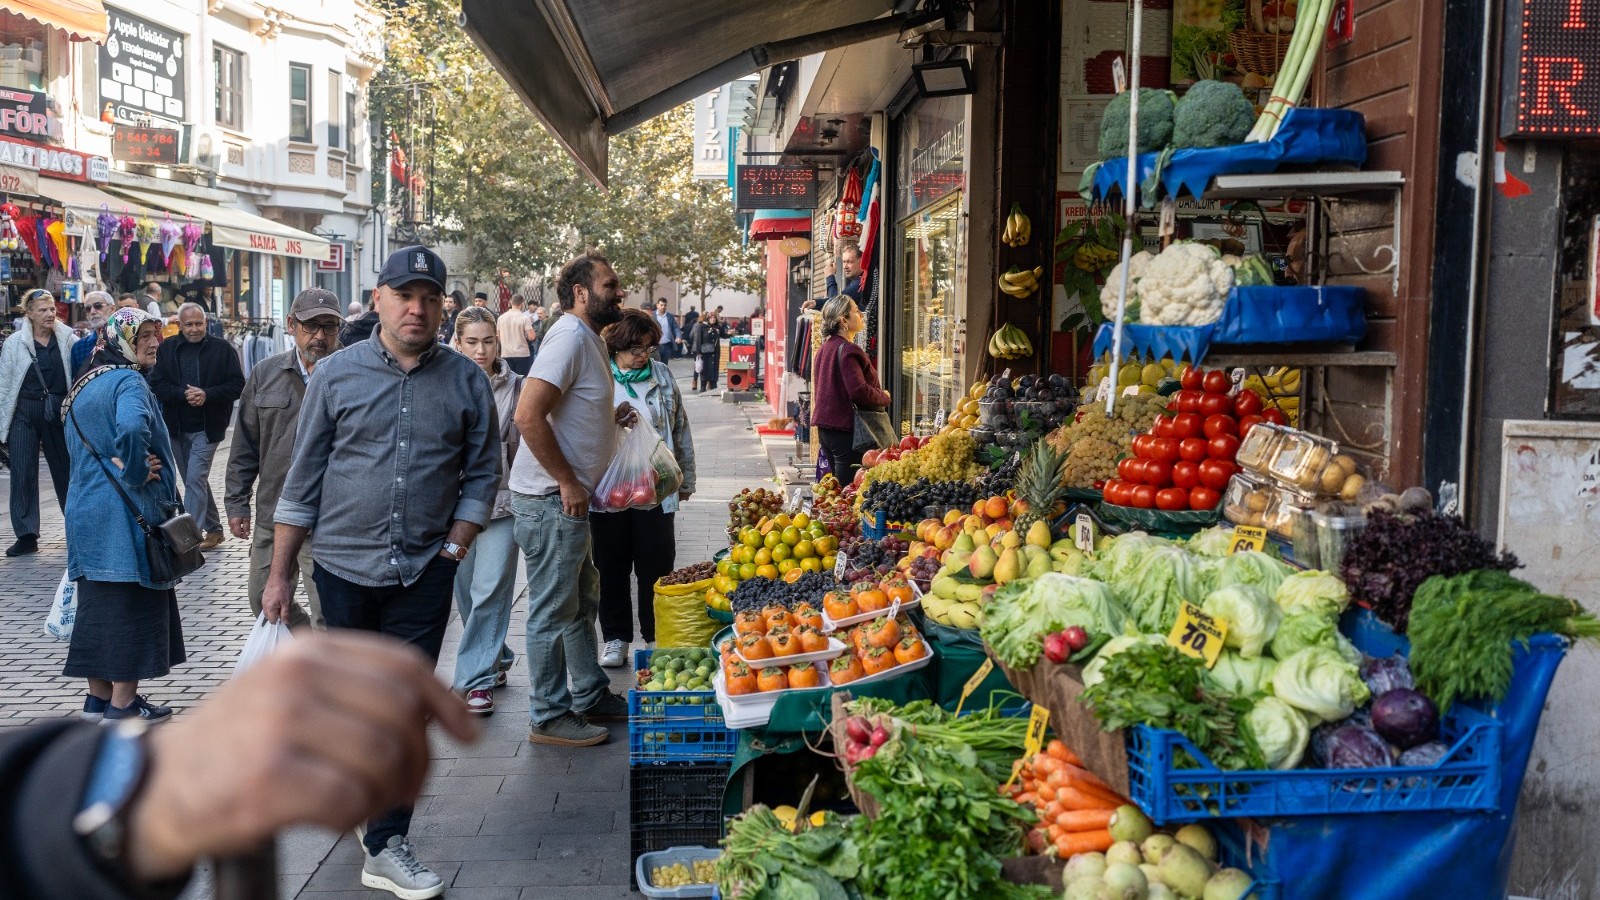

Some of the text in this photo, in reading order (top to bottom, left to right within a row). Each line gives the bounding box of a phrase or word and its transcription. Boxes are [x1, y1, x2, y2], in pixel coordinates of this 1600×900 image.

[114, 17, 169, 49] Apple Üsküdar
[0, 91, 15, 99] RAT
[1530, 57, 1588, 116] R
[0, 105, 48, 135] FÖR
[38, 147, 83, 175] BAGS
[743, 169, 813, 181] 15/10/2025
[0, 174, 20, 191] 972
[250, 234, 302, 255] NAMA JNS
[1180, 621, 1208, 652] 70
